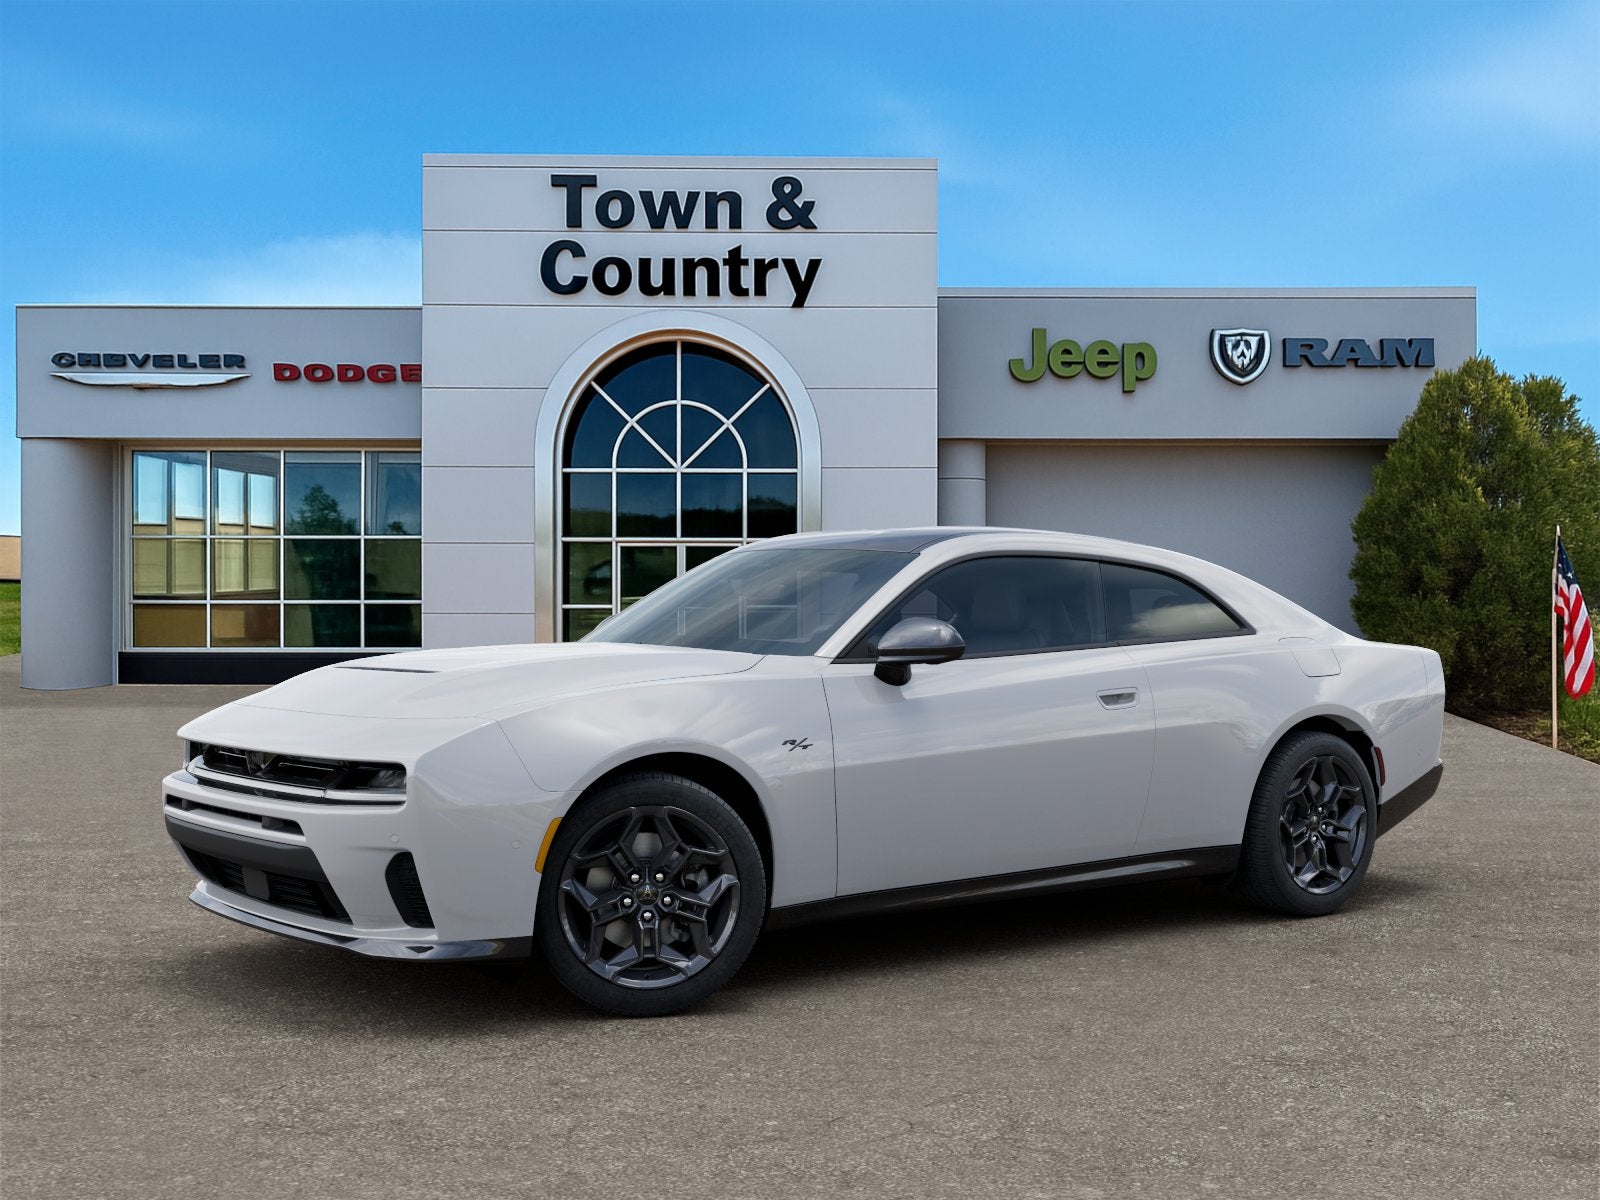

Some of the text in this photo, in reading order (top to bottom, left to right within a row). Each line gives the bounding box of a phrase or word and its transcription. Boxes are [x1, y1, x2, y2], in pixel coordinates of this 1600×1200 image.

[550, 174, 818, 230] Town &
[540, 239, 822, 308] Country
[273, 363, 422, 383] DODGE
[1008, 328, 1158, 393] Jeep
[1282, 337, 1436, 368] RAM
